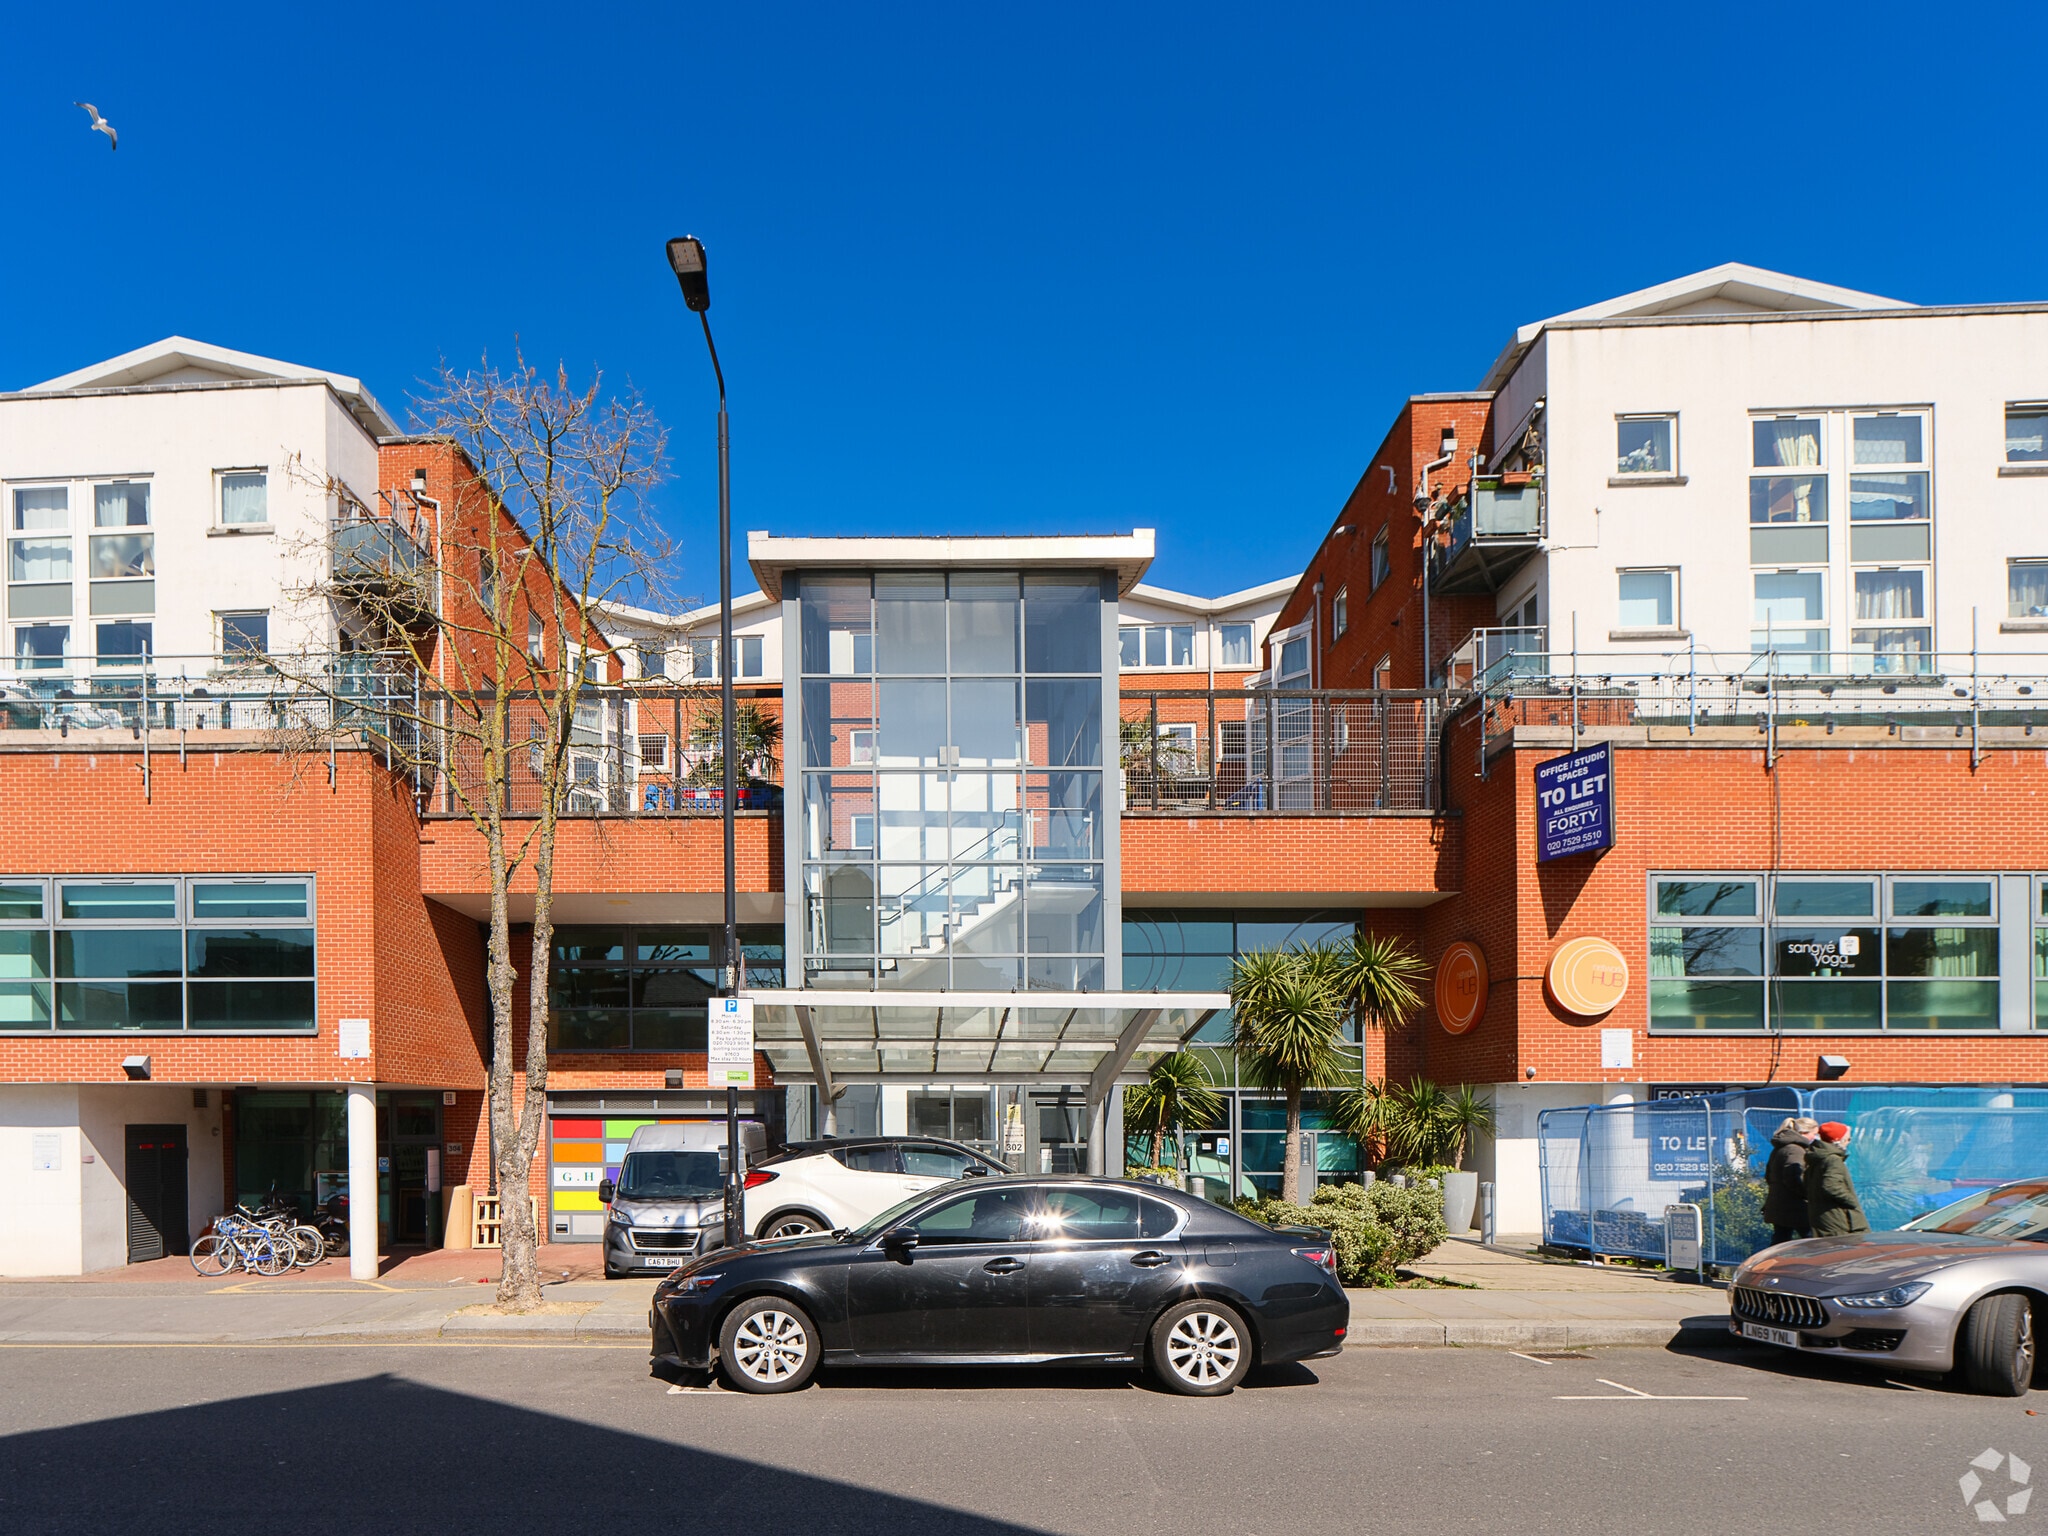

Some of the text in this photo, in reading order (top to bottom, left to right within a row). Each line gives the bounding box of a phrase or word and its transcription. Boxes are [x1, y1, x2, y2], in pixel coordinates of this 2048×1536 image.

[1540, 762, 1569, 778] OFFICE
[1574, 750, 1606, 767] STUDIO
[1557, 766, 1589, 783] SPACES
[1540, 773, 1607, 808] TO LET
[1548, 808, 1599, 834] FORTY
[1564, 826, 1583, 835] GROUP
[1547, 830, 1602, 851] 020 7529 5510
[1788, 940, 1835, 956] sangyé
[1814, 954, 1849, 967] yoga
[1456, 976, 1477, 996] HUB
[1591, 970, 1624, 987] HUB
[728, 1001, 736, 1011] P
[1658, 1090, 1718, 1104] FORTY
[1659, 1136, 1717, 1151] TO LET
[1654, 1163, 1673, 1171] 020
[1746, 1324, 1792, 1345] LN69 YNL
